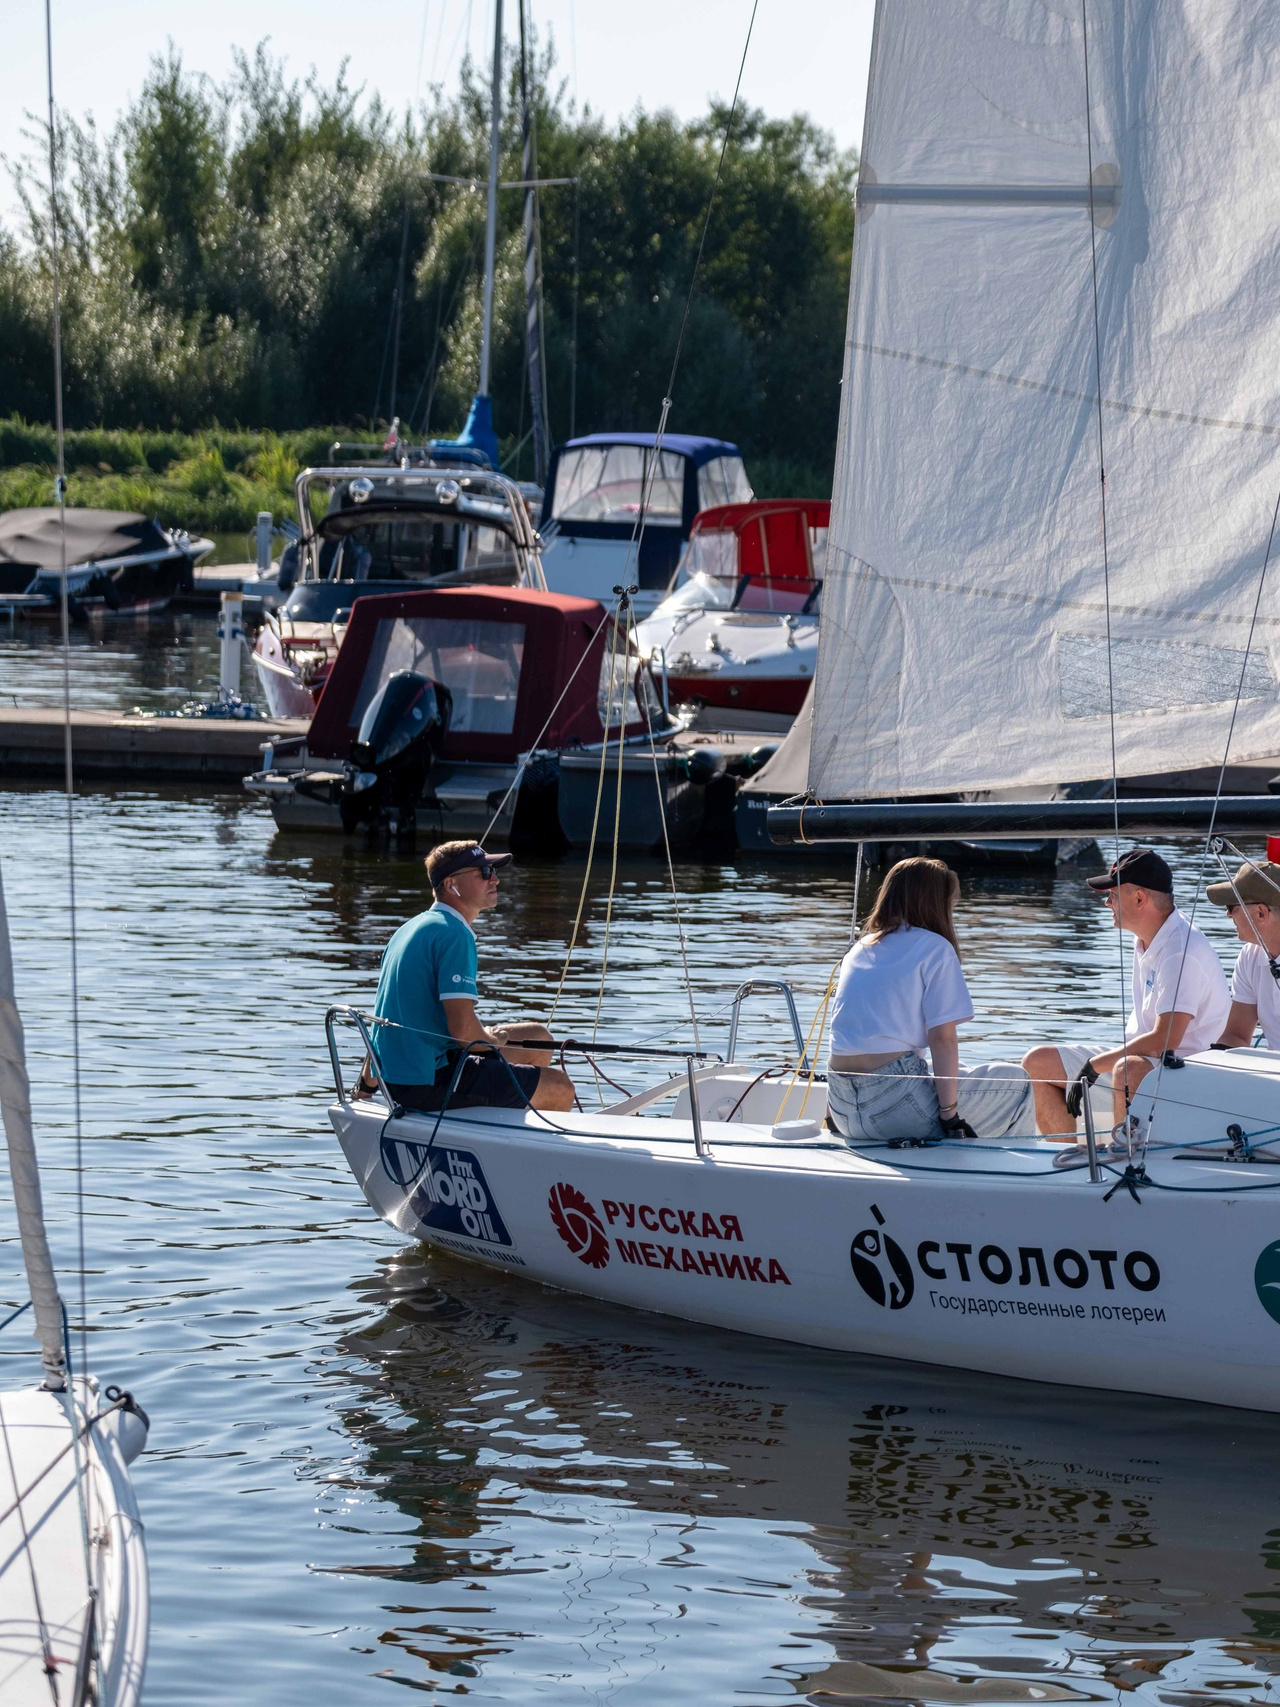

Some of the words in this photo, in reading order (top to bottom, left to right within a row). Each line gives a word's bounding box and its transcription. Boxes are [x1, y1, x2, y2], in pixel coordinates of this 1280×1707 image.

[460, 1207, 500, 1242] OIL
[601, 1199, 744, 1242] РУССКАЯ
[615, 1238, 792, 1286] МЕХАНИКА
[916, 1240, 1161, 1292] СТОЛОТО
[928, 1290, 1086, 1317] Государственные
[1090, 1305, 1167, 1326] лотереи
